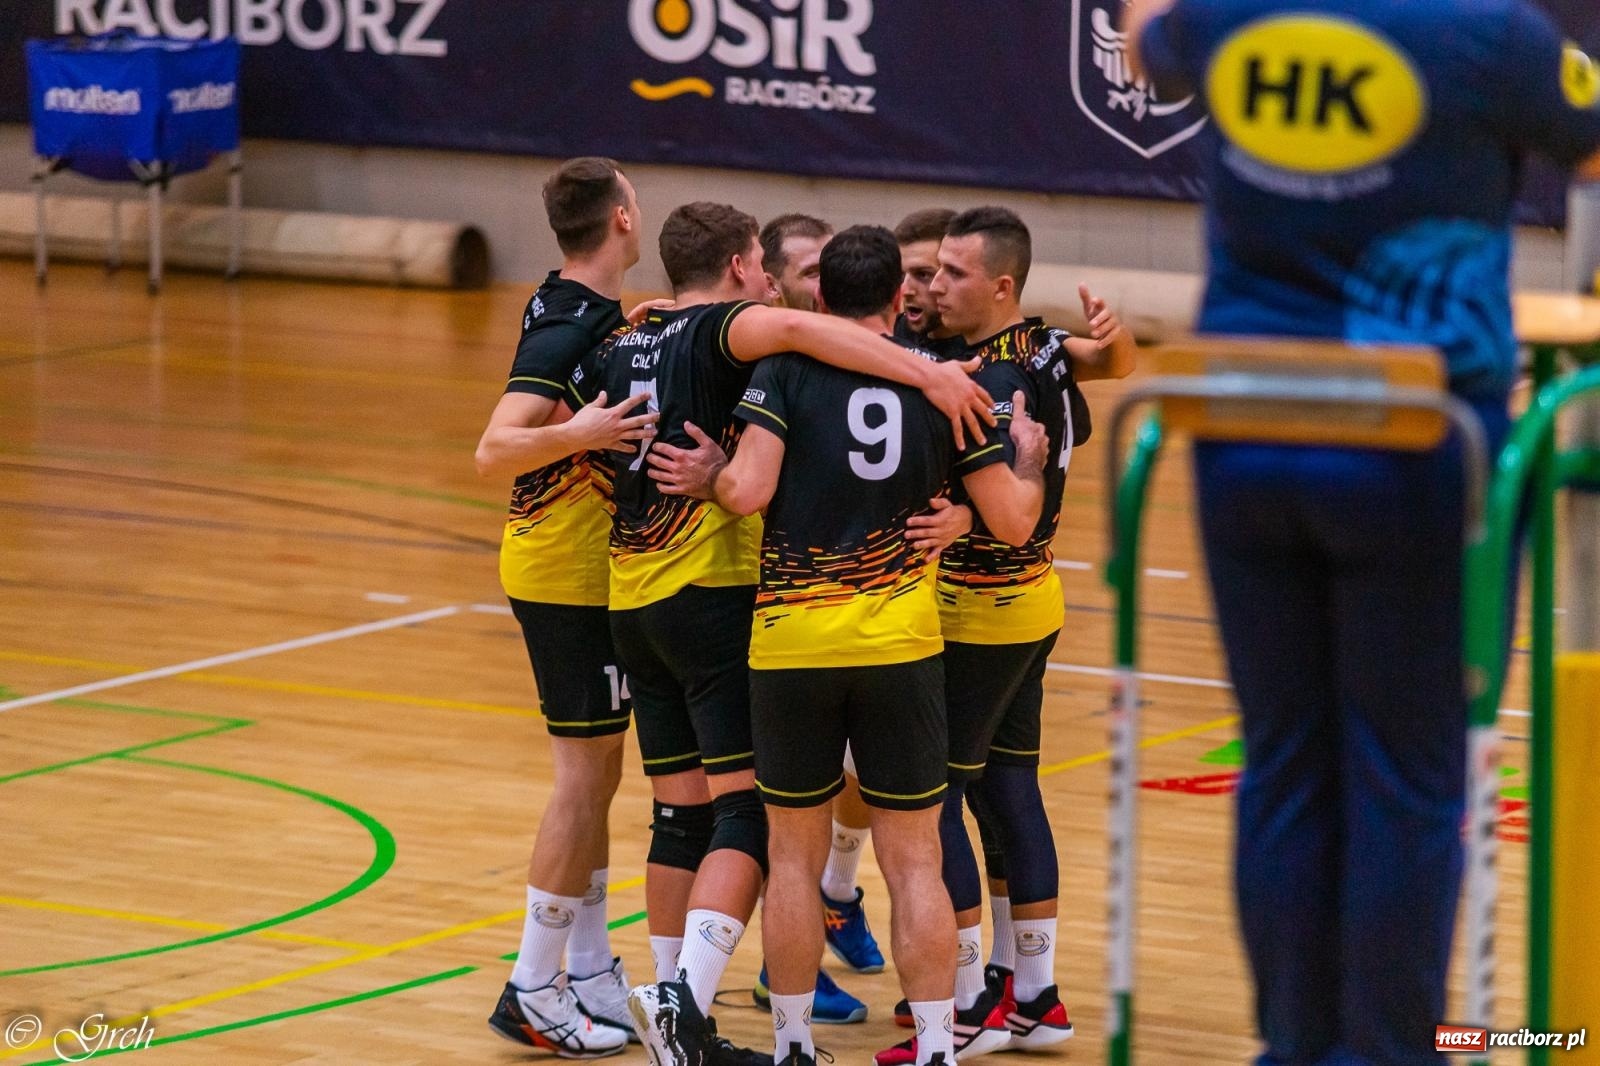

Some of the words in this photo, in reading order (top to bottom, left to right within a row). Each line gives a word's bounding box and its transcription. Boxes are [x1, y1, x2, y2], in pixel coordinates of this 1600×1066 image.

[44, 84, 141, 115] molten
[724, 76, 877, 114] RACIBÓRZ
[1241, 53, 1380, 137] HK
[847, 387, 902, 481] 9
